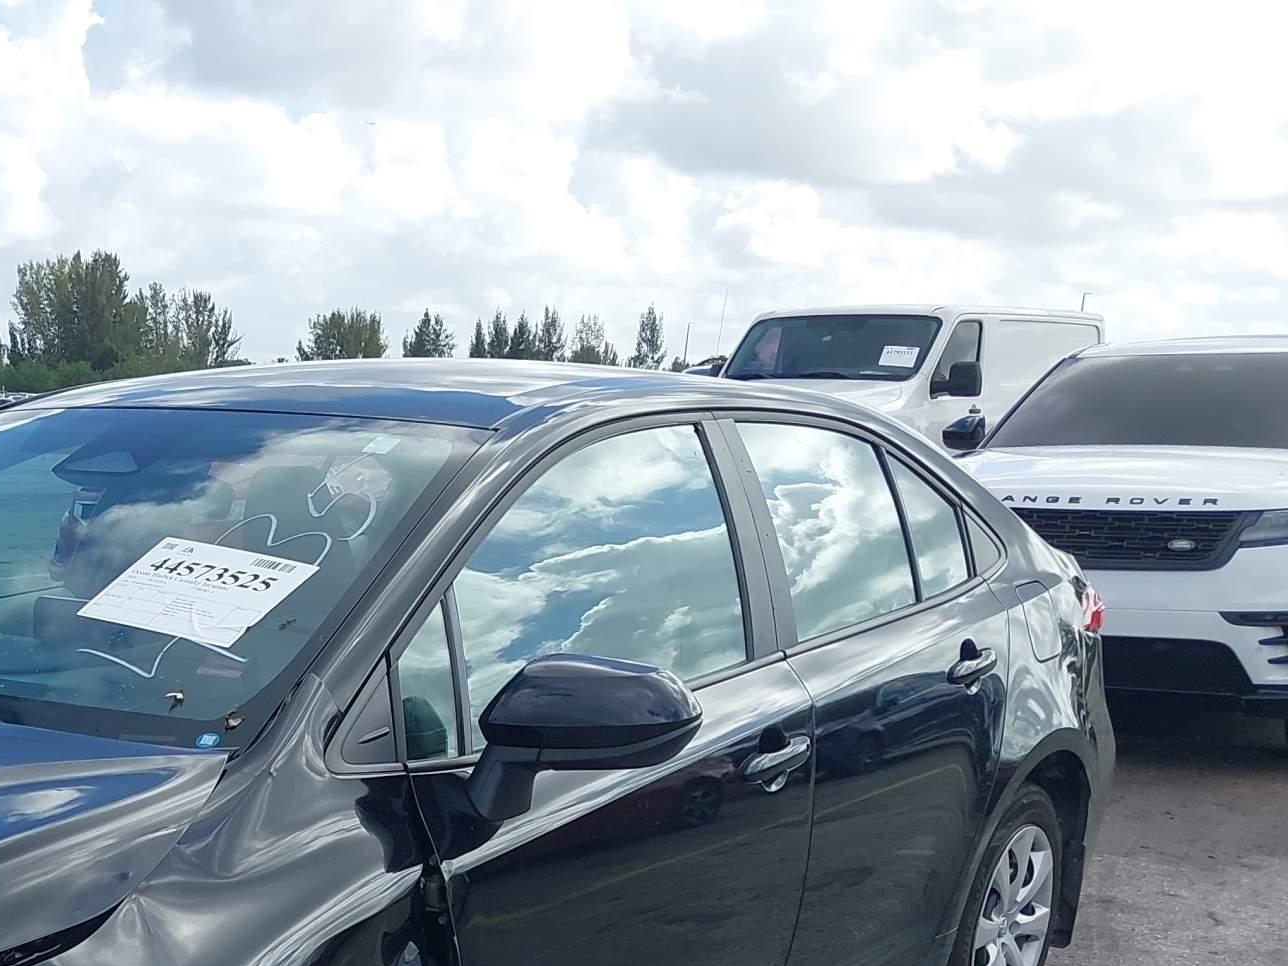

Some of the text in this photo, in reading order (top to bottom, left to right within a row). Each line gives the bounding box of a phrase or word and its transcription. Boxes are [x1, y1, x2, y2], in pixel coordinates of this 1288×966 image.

[1000, 495, 1219, 506] ANGE ROVER
[150, 557, 280, 593] 44573525
